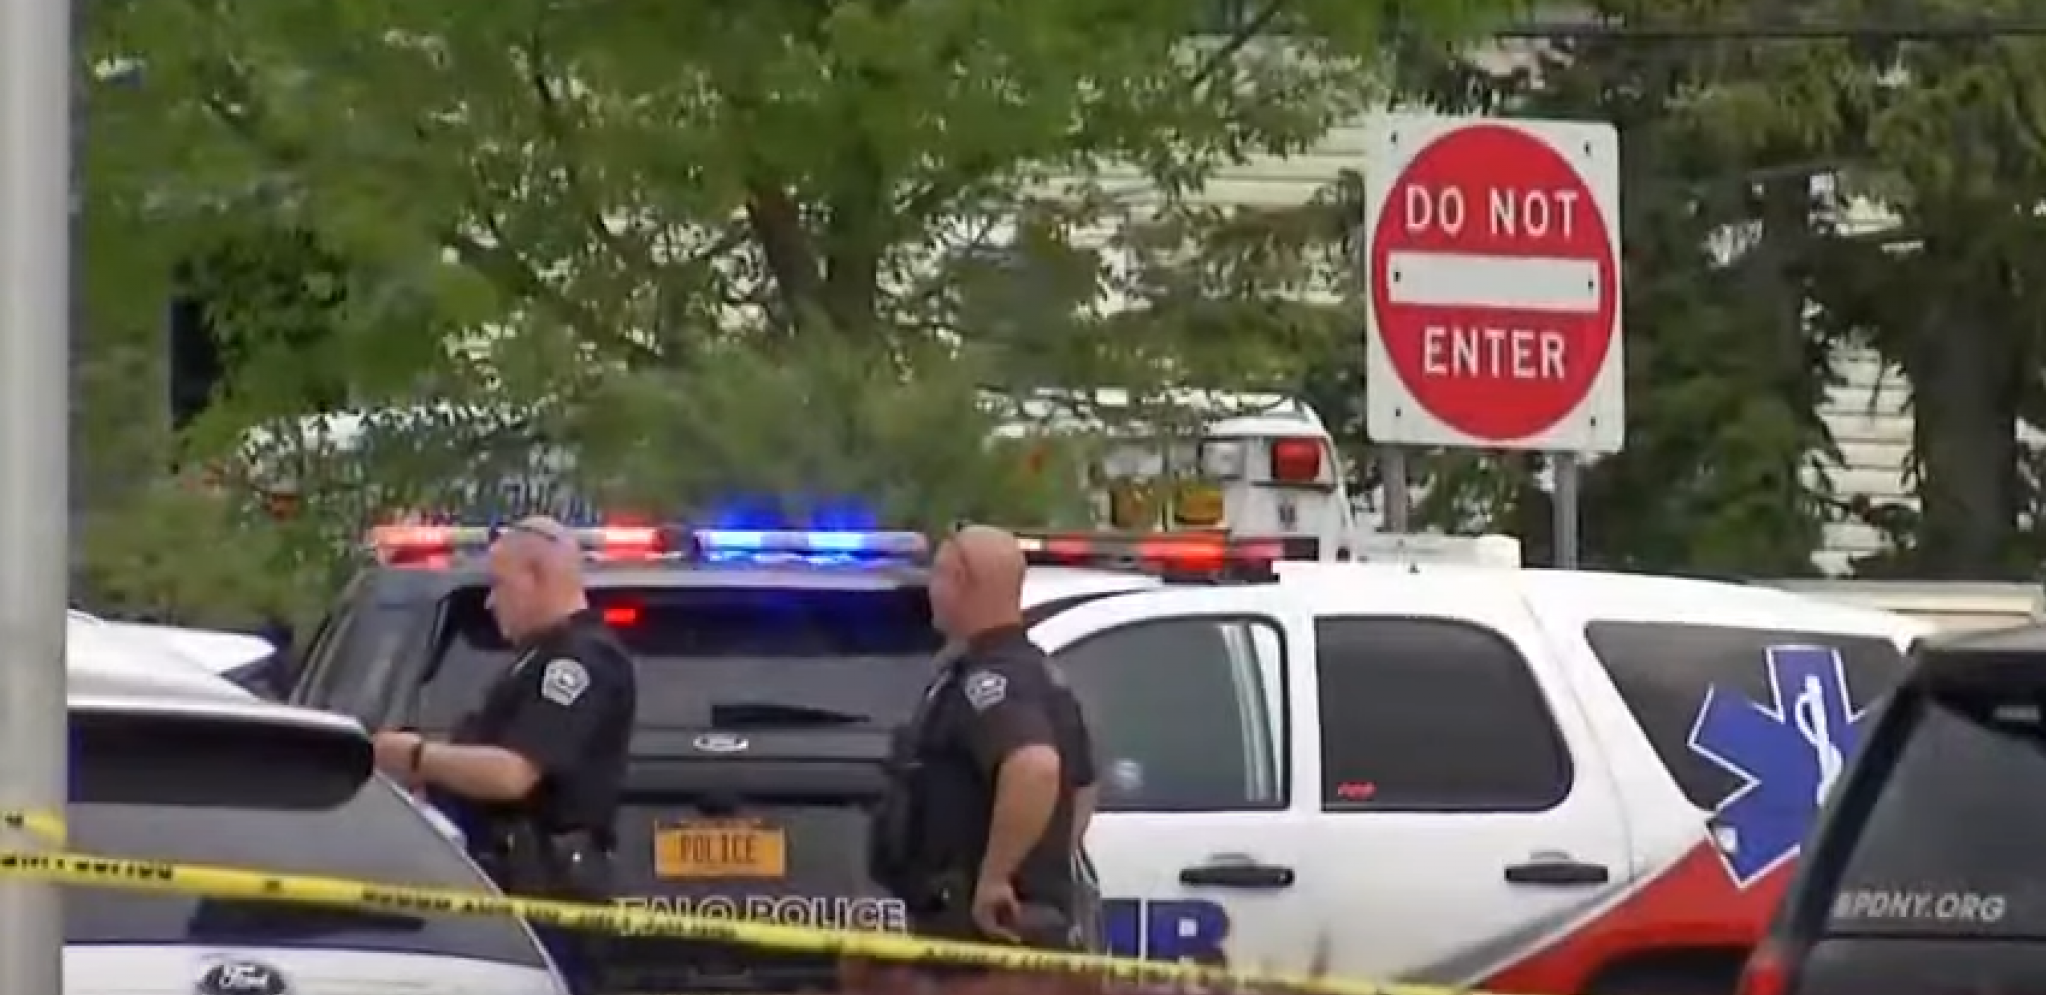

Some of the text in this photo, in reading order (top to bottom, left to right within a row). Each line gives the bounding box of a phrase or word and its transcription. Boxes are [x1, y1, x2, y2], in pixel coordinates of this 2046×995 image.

[1405, 184, 1580, 241] DO NOT
[1424, 325, 1567, 380] ENTER
[679, 832, 758, 865] POLICE
[746, 895, 907, 935] POLICE
